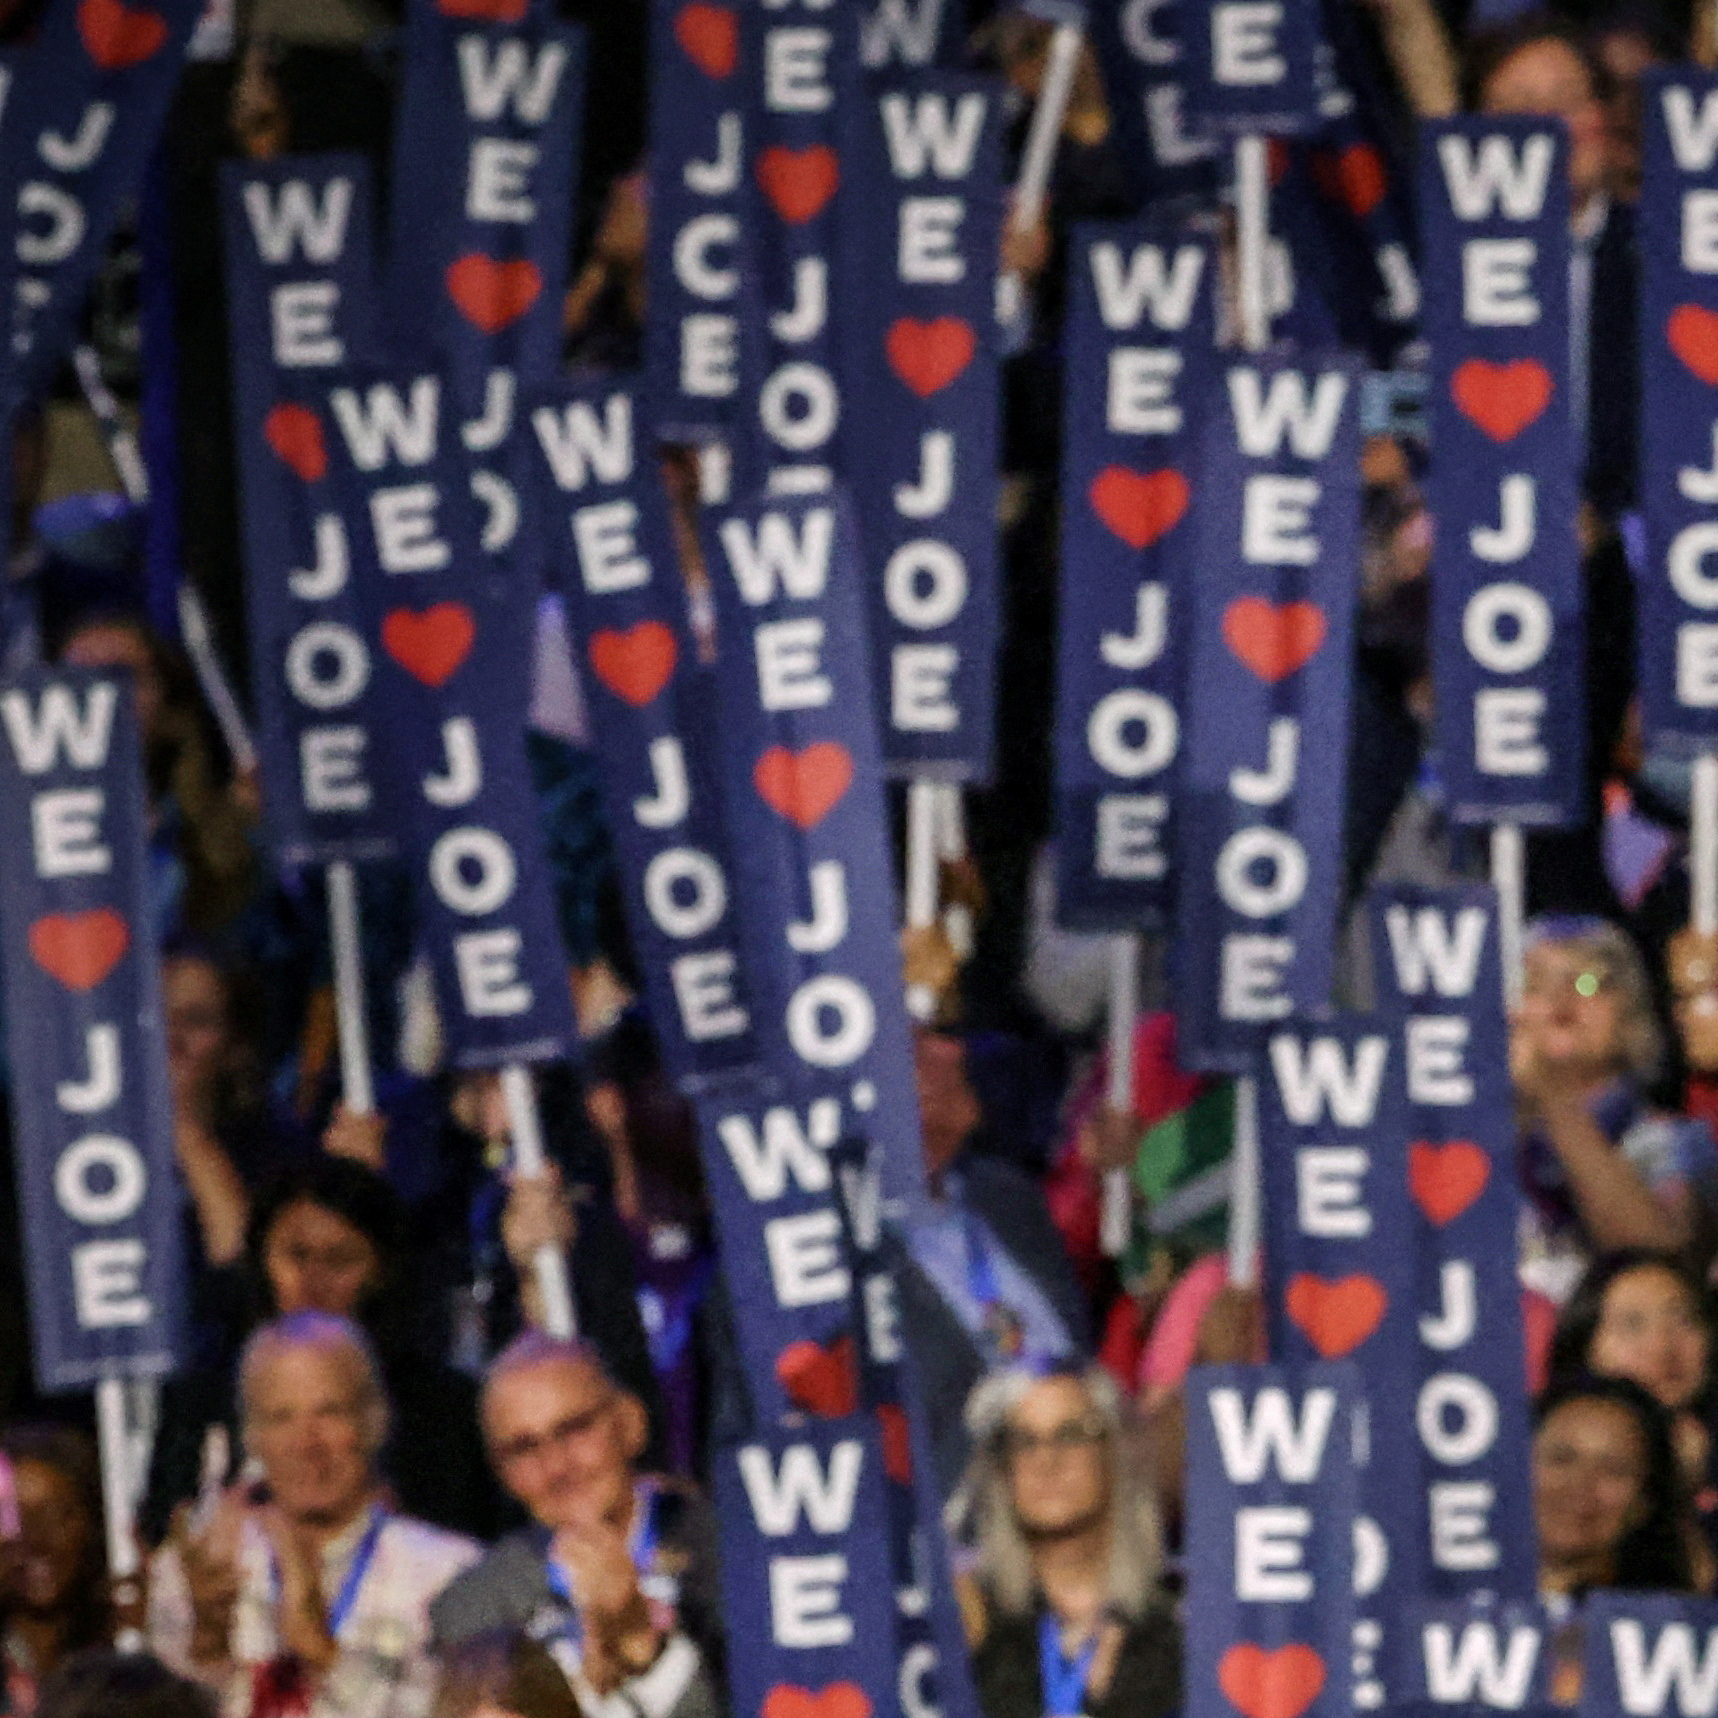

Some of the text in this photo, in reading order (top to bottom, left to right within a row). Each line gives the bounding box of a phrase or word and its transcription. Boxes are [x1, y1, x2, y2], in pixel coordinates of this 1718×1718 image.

[464, 44, 560, 218] WE
[886, 98, 982, 281] WE
[762, 260, 835, 494] JO
[1094, 246, 1201, 432] WE
[1442, 138, 1550, 774] WE JOE
[251, 185, 364, 805] WE JOE
[886, 433, 966, 730] JOE
[336, 381, 529, 1013] WE JOE
[537, 398, 743, 1036] WE JOE
[723, 509, 877, 1112] WE JO
[1090, 585, 1176, 874] JOE
[1218, 370, 1346, 1018] WE JOE
[0, 686, 151, 1326] WE JOE
[1272, 1037, 1386, 1236] WE
[720, 1099, 849, 1307] WE
[1388, 908, 1497, 1568] WE JOE
[740, 1442, 862, 1648] WE
[1208, 1387, 1336, 1602] WE
